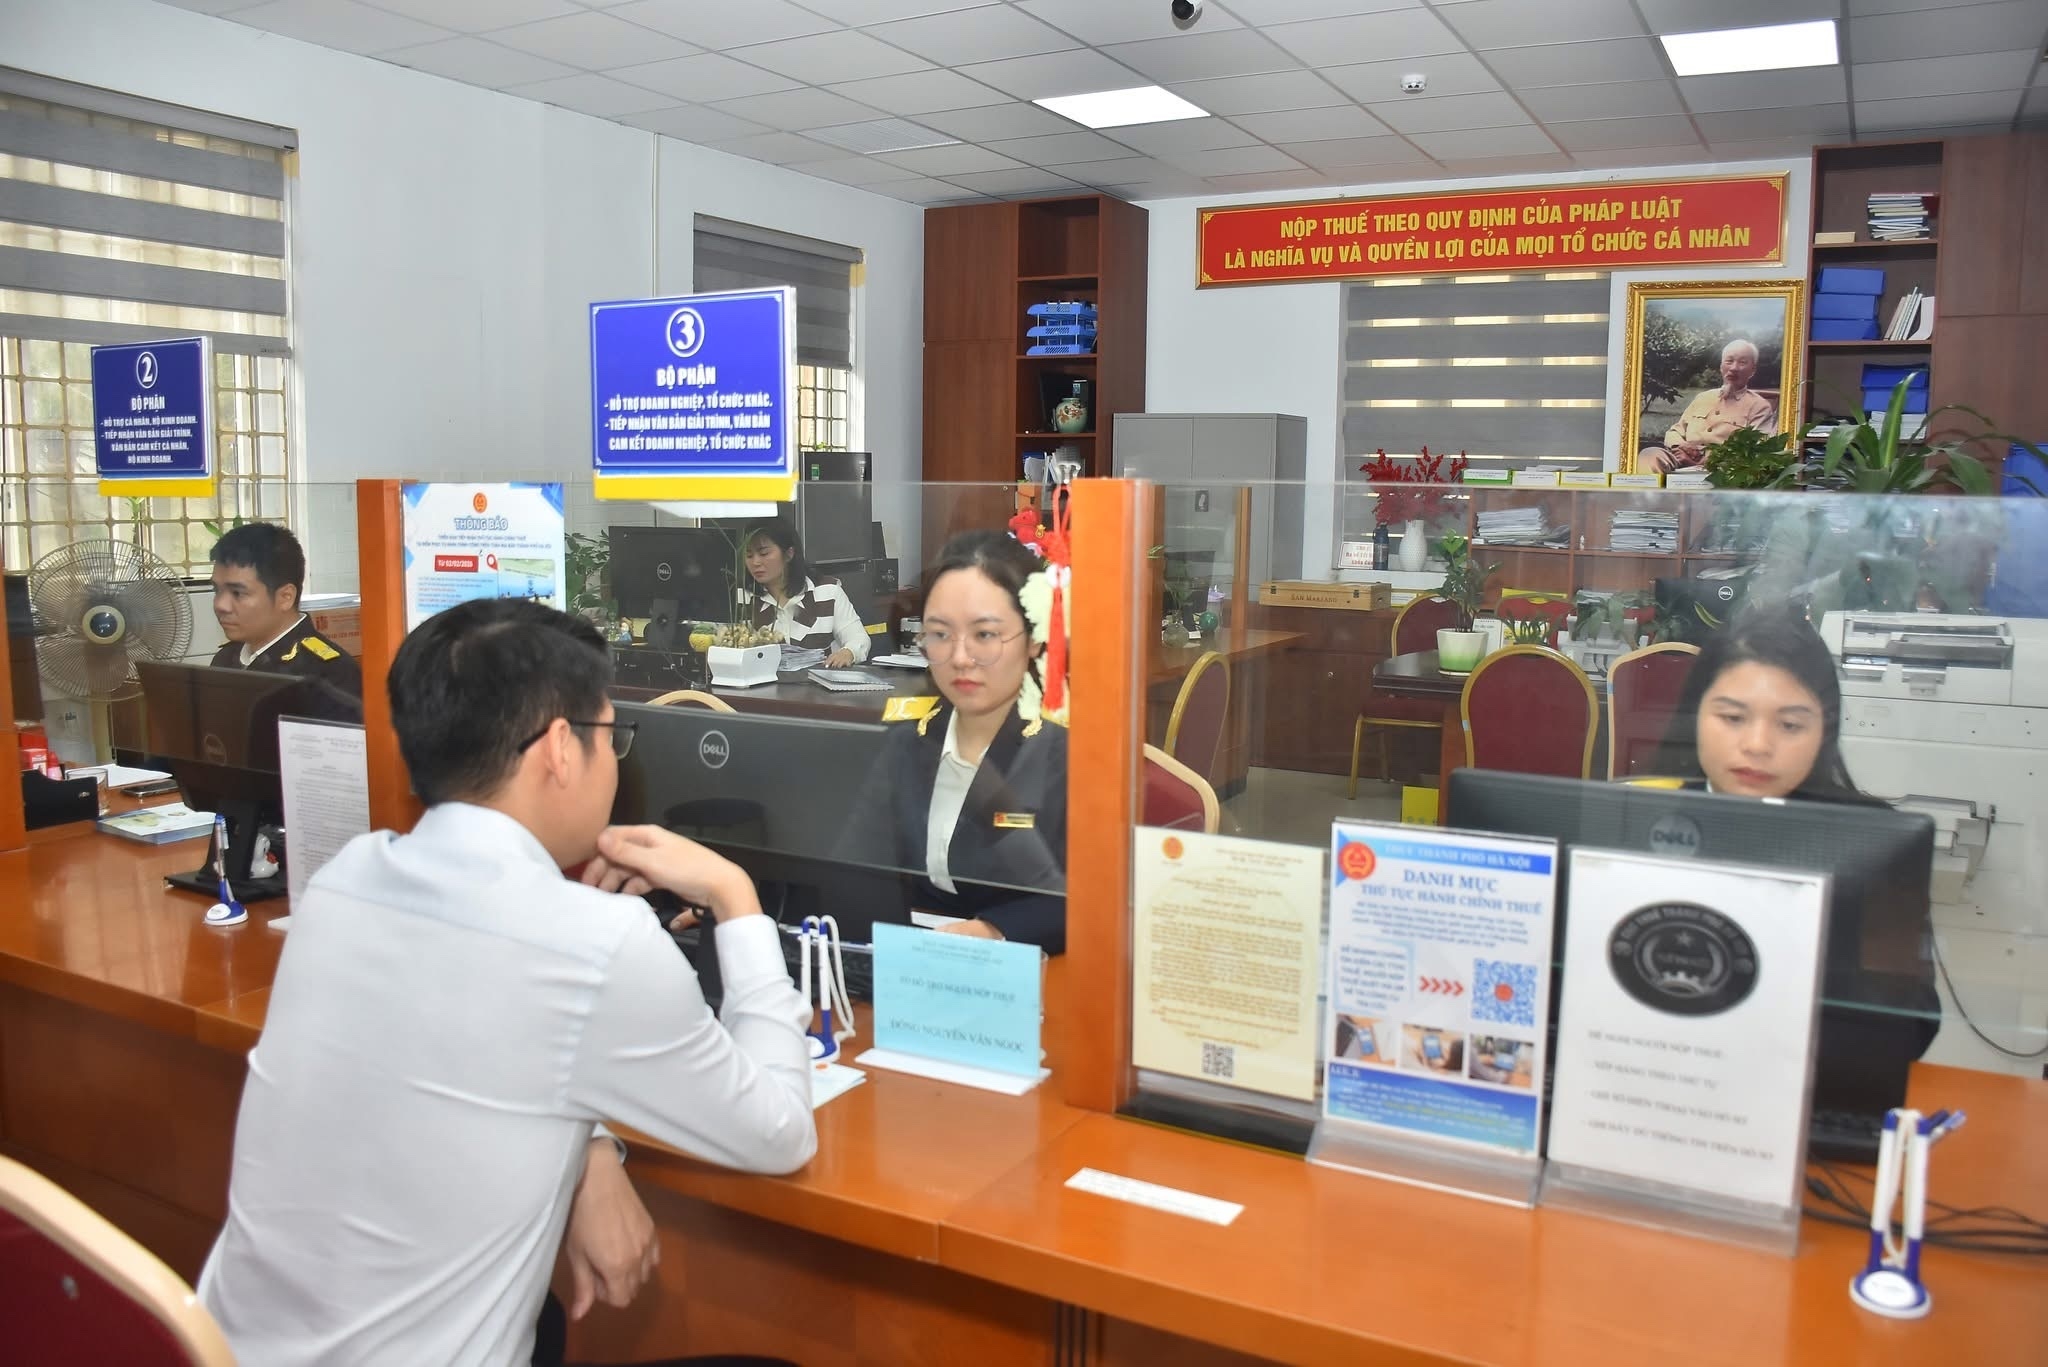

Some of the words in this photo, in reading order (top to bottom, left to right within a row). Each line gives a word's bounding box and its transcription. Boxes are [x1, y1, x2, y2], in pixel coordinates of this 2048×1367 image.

[1280, 216, 1318, 240] NỘP
[1323, 209, 1369, 235] THUẾ
[1374, 213, 1420, 233] THEO
[1426, 211, 1464, 231] QUY
[1468, 210, 1517, 231] ĐỊNH
[1522, 199, 1563, 225] CỦA
[1569, 199, 1625, 223] PHÁP
[1631, 196, 1683, 221] LUẬT
[1225, 243, 1247, 269] LÀ
[1251, 242, 1306, 268] NGHĨA
[1310, 247, 1334, 268] VỤ
[1338, 240, 1362, 264] VÀ
[1367, 235, 1430, 263] QUYỀN
[1435, 238, 1466, 262] LỢI
[1470, 230, 1511, 257] CỦA
[1516, 234, 1555, 258] MỌI
[1561, 227, 1587, 254] TỔ
[1591, 226, 1647, 252] CHỨC
[1652, 226, 1683, 250] CÁ
[1688, 224, 1751, 249] NHÂN
[675, 313, 696, 350] 3
[141, 356, 153, 383] 2
[656, 364, 676, 389] BỘ
[677, 363, 716, 389] PHẬN
[131, 394, 142, 413] BỘ
[143, 393, 165, 413] PHẬN
[640, 397, 670, 410] DOANH
[609, 436, 629, 451] CAM
[629, 432, 645, 450] KẾT
[646, 436, 674, 449] DOANH
[747, 433, 771, 449] KHÁC
[454, 516, 487, 531] THÔNG
[488, 515, 509, 531] BÁO
[1404, 869, 1453, 887] DANH
[1458, 875, 1498, 895] MỤC
[1391, 887, 1414, 901] TỤC
[1417, 889, 1456, 904] HÀNH
[1459, 893, 1503, 911] CHÍNH
[1507, 900, 1543, 914] THUẾ
